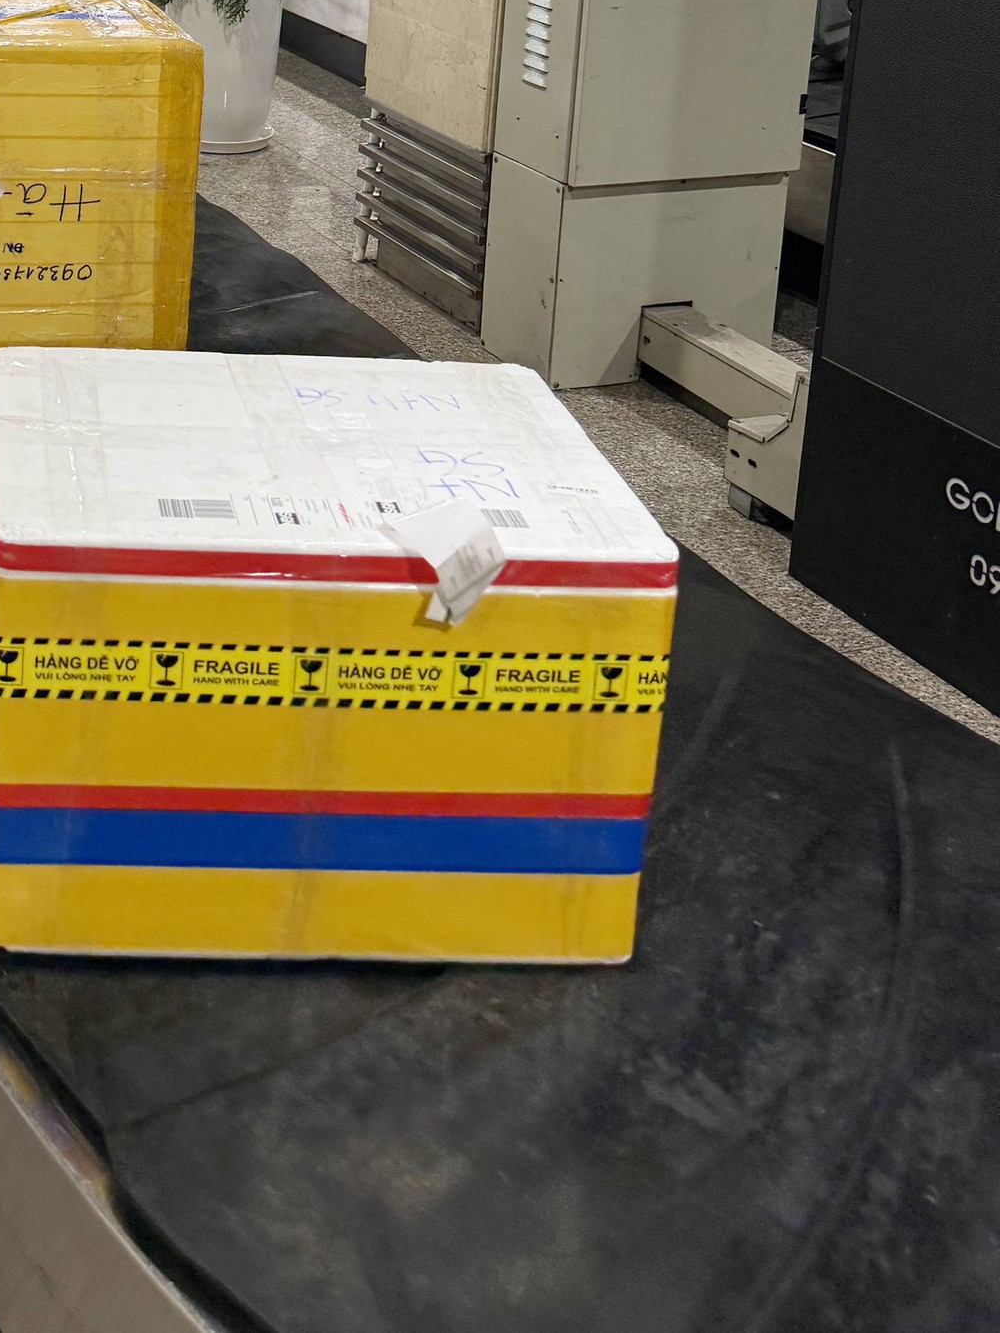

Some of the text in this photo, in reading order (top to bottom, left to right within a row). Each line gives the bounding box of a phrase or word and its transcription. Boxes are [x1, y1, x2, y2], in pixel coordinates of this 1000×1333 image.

[945, 477, 1000, 533] GO
[34, 653, 82, 669] HÀNG
[193, 659, 280, 676] FRAGILE
[35, 671, 136, 682] VUI LÒNG NHẸ TAY
[338, 663, 386, 680] HÀNG
[495, 668, 581, 683] FRAGILE
[638, 669, 668, 684] HÀN
[193, 677, 280, 687] HAND WITH CARE
[338, 682, 357, 690] VUI
[359, 682, 390, 691] LÒNG
[419, 684, 439, 692] TAY
[495, 685, 580, 694] HAND WITH CARE
